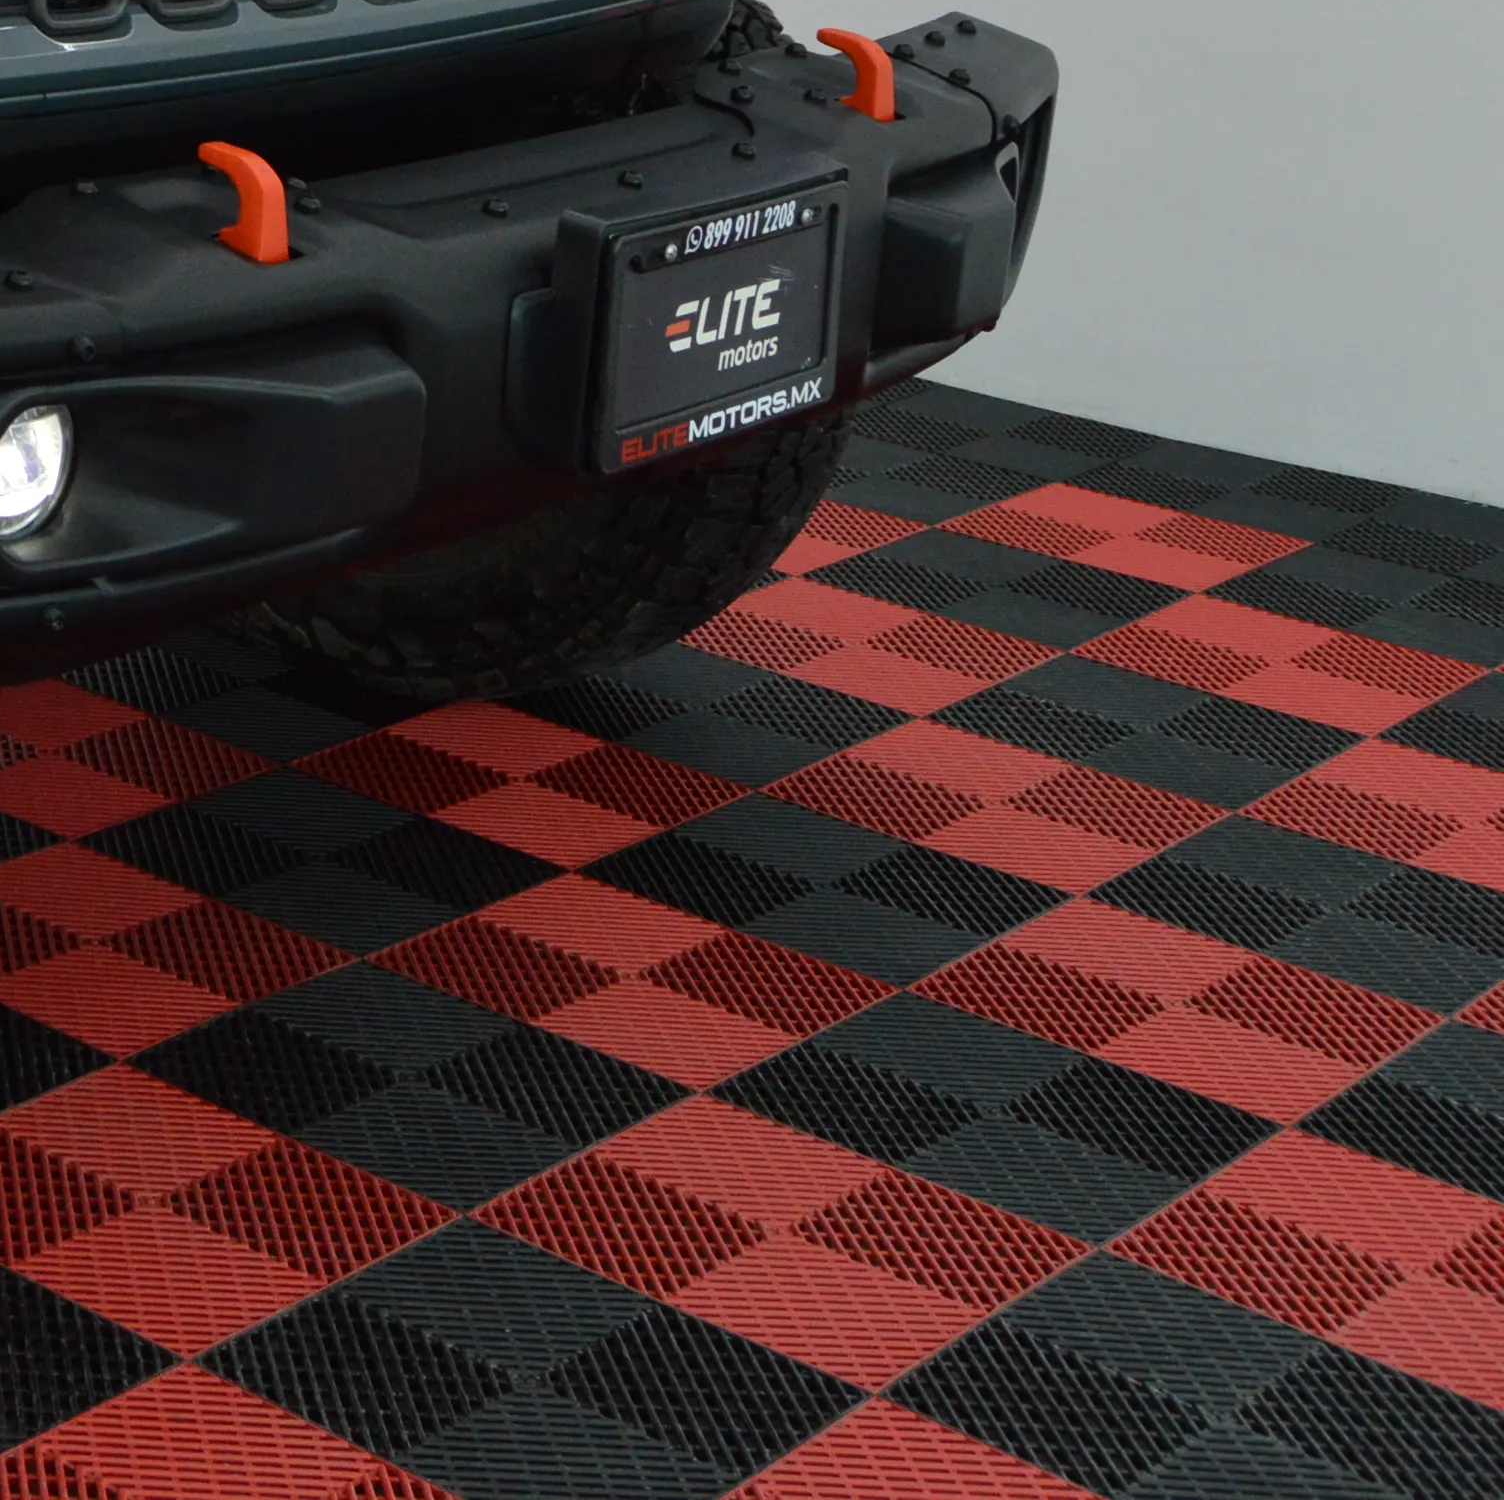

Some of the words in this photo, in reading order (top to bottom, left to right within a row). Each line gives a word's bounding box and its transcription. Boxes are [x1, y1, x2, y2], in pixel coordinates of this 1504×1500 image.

[704, 218, 733, 250] 899
[734, 210, 760, 242] 911
[762, 200, 796, 234] 2208
[665, 278, 781, 353] ELITE
[718, 336, 779, 371] motors
[621, 377, 823, 464] ELITEMOTORS.MX
